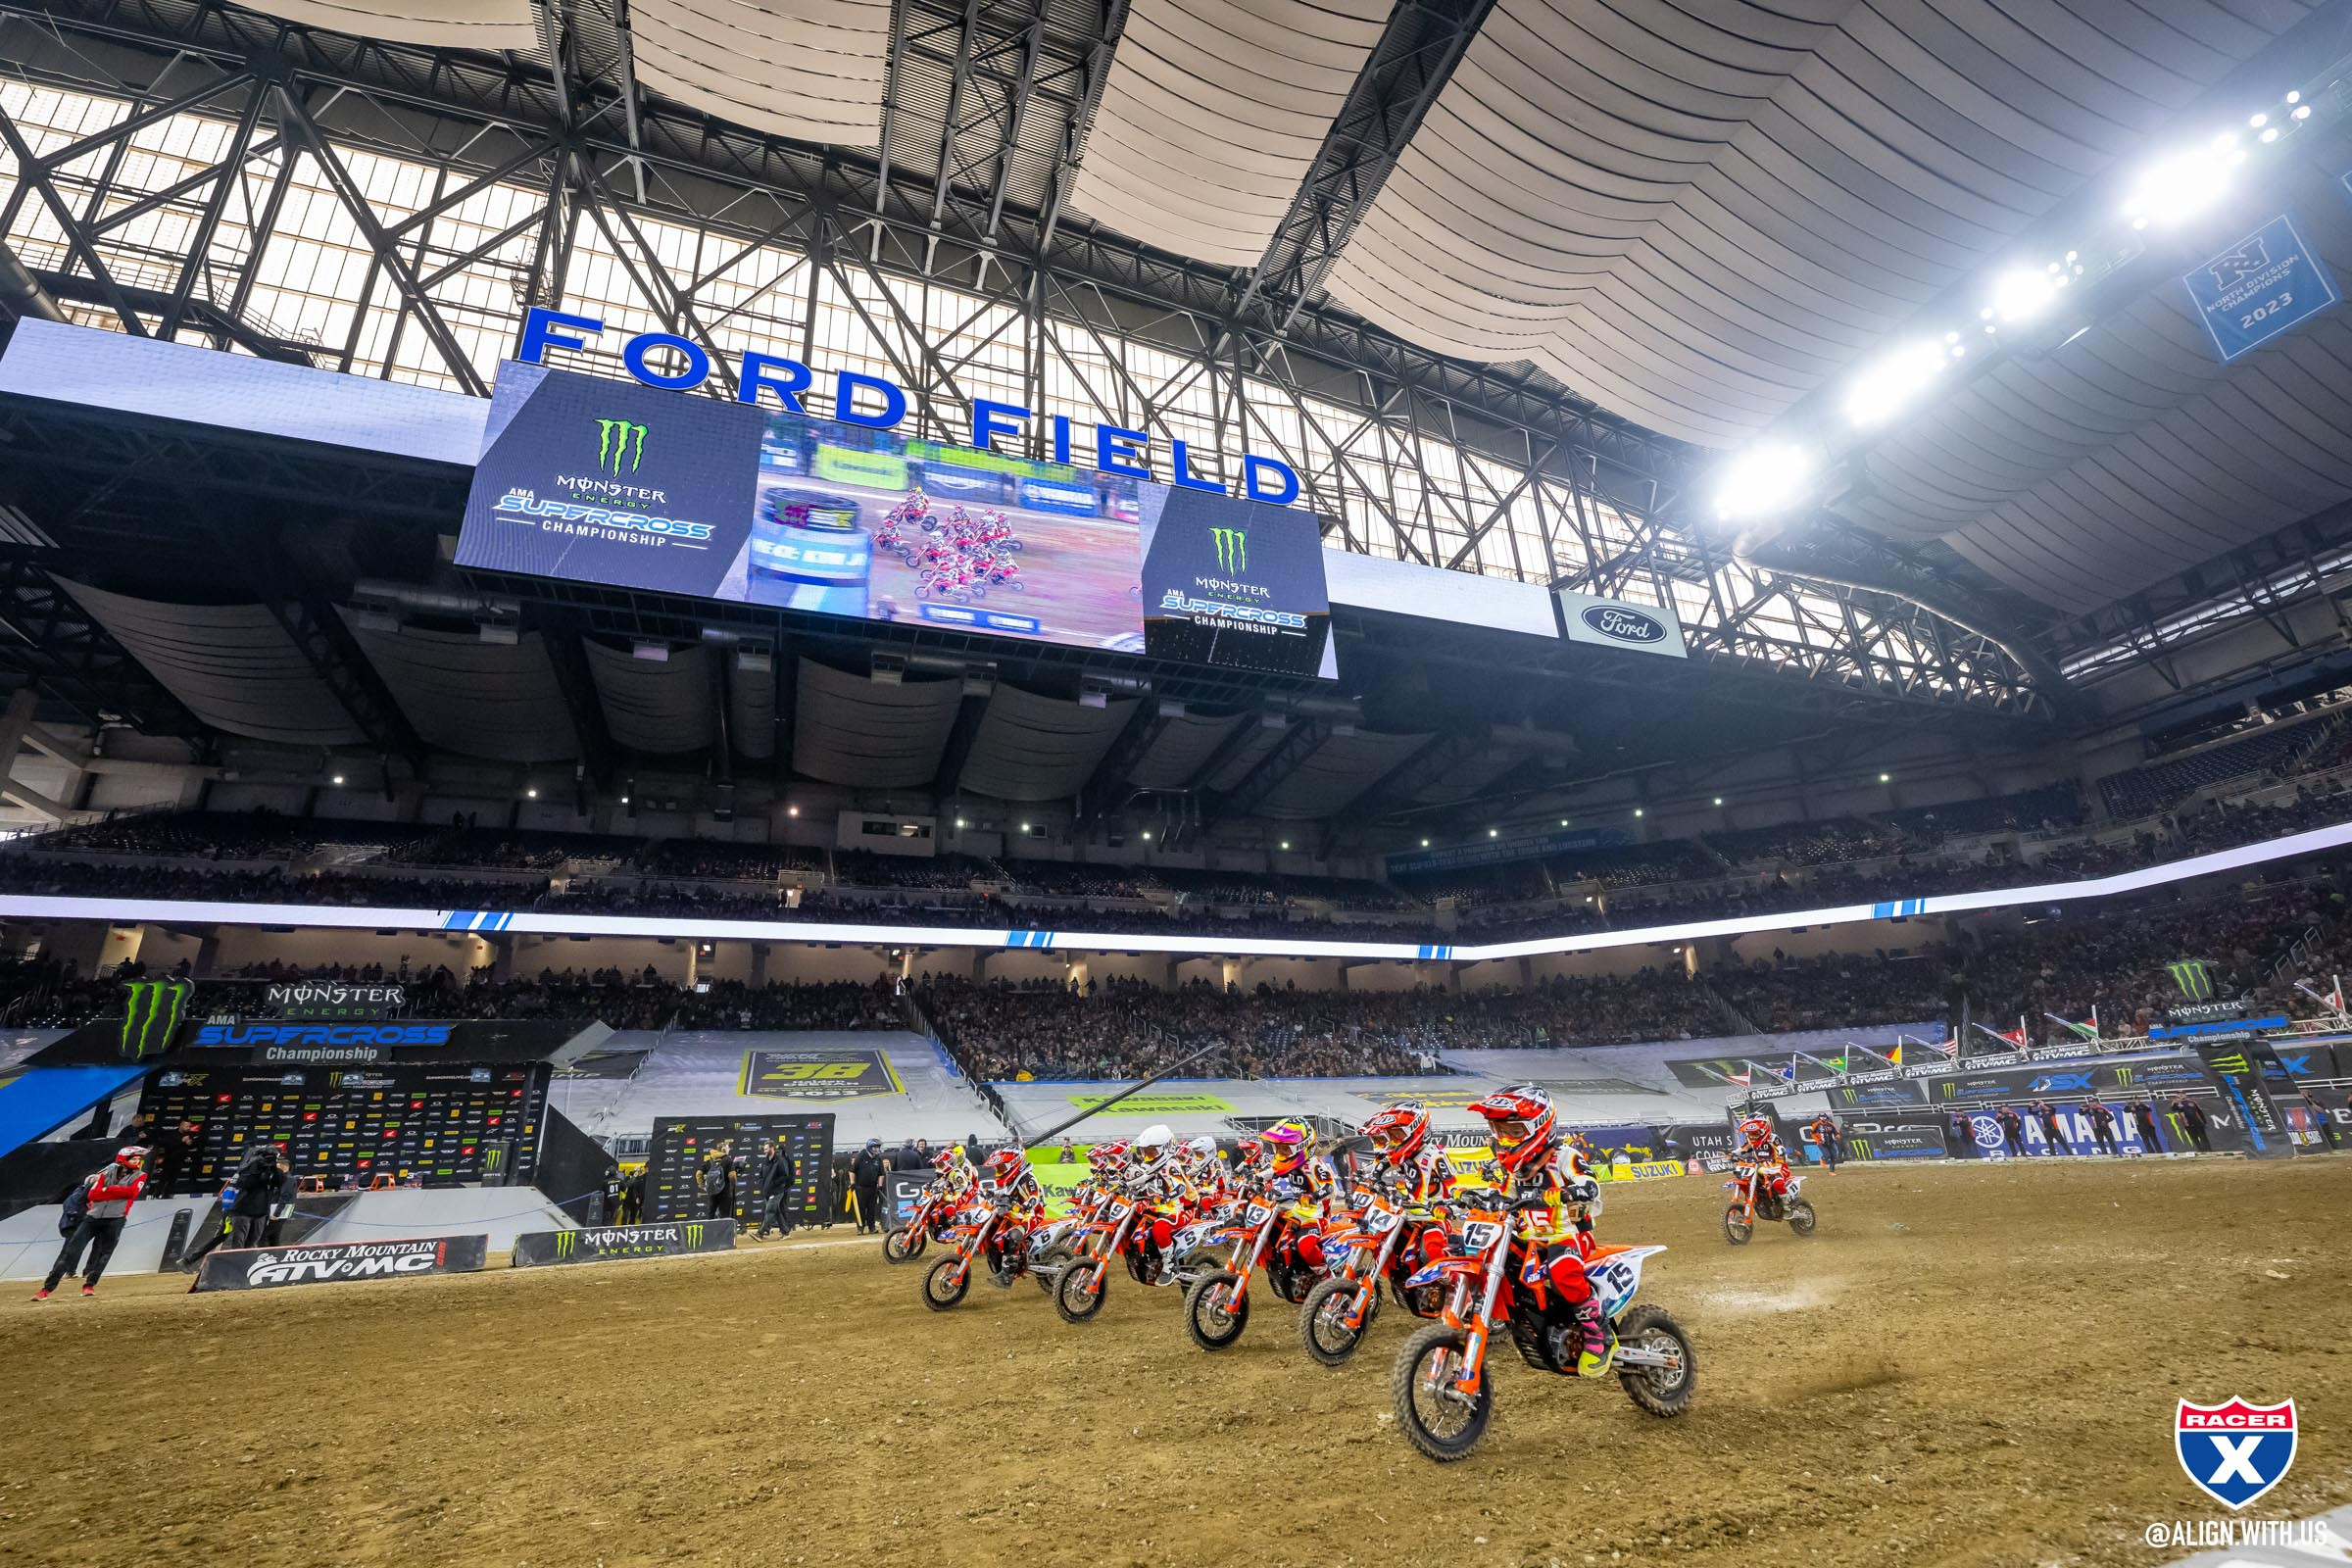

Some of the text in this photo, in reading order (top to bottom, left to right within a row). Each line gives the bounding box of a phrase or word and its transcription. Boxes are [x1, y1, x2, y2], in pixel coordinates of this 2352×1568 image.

[2206, 254, 2300, 313] NORTH DIVISION
[2222, 269, 2291, 313] CHAMPIONS
[2240, 292, 2293, 329] 2023
[517, 306, 1300, 507] FORD FIELD
[509, 487, 535, 499] AMA
[557, 474, 667, 504] MONSTER
[571, 493, 652, 511] ENERGY
[492, 495, 716, 540] SUPERCROSS
[542, 519, 666, 547] CHAMPIONSHIP
[1167, 589, 1184, 598] AMA
[1195, 576, 1270, 598] MONSTER
[1207, 591, 1261, 604] ENERGY
[1159, 595, 1308, 629] SUPERCROSS
[1194, 615, 1278, 635] CHAMPIONSHIP
[1600, 610, 1650, 638] Ford
[268, 984, 404, 1004] MONSTER
[207, 1015, 236, 1026] AMA
[286, 1007, 381, 1016] ENERGY
[192, 1026, 453, 1046] SUPERCROSS
[2187, 1030, 2251, 1044] Championship
[266, 1047, 378, 1062] Championship
[761, 1062, 871, 1080] 38
[1446, 1134, 1487, 1148] MOUN
[1692, 1136, 1733, 1147] UTAH S
[1451, 1160, 1487, 1175] UZU
[1630, 1163, 1678, 1179] SUZUKI
[1111, 1203, 1124, 1216] 9
[1354, 1194, 1369, 1207] 10
[1248, 1205, 1266, 1221] 13
[1369, 1209, 1392, 1227] 14
[1524, 1210, 1550, 1231] 15
[584, 1228, 679, 1248] MONSTER
[1464, 1223, 1494, 1248] 15
[280, 1241, 438, 1263] ROCKY MOUNTAIN
[598, 1245, 664, 1255] ENERGY
[1607, 1262, 1635, 1295] 15
